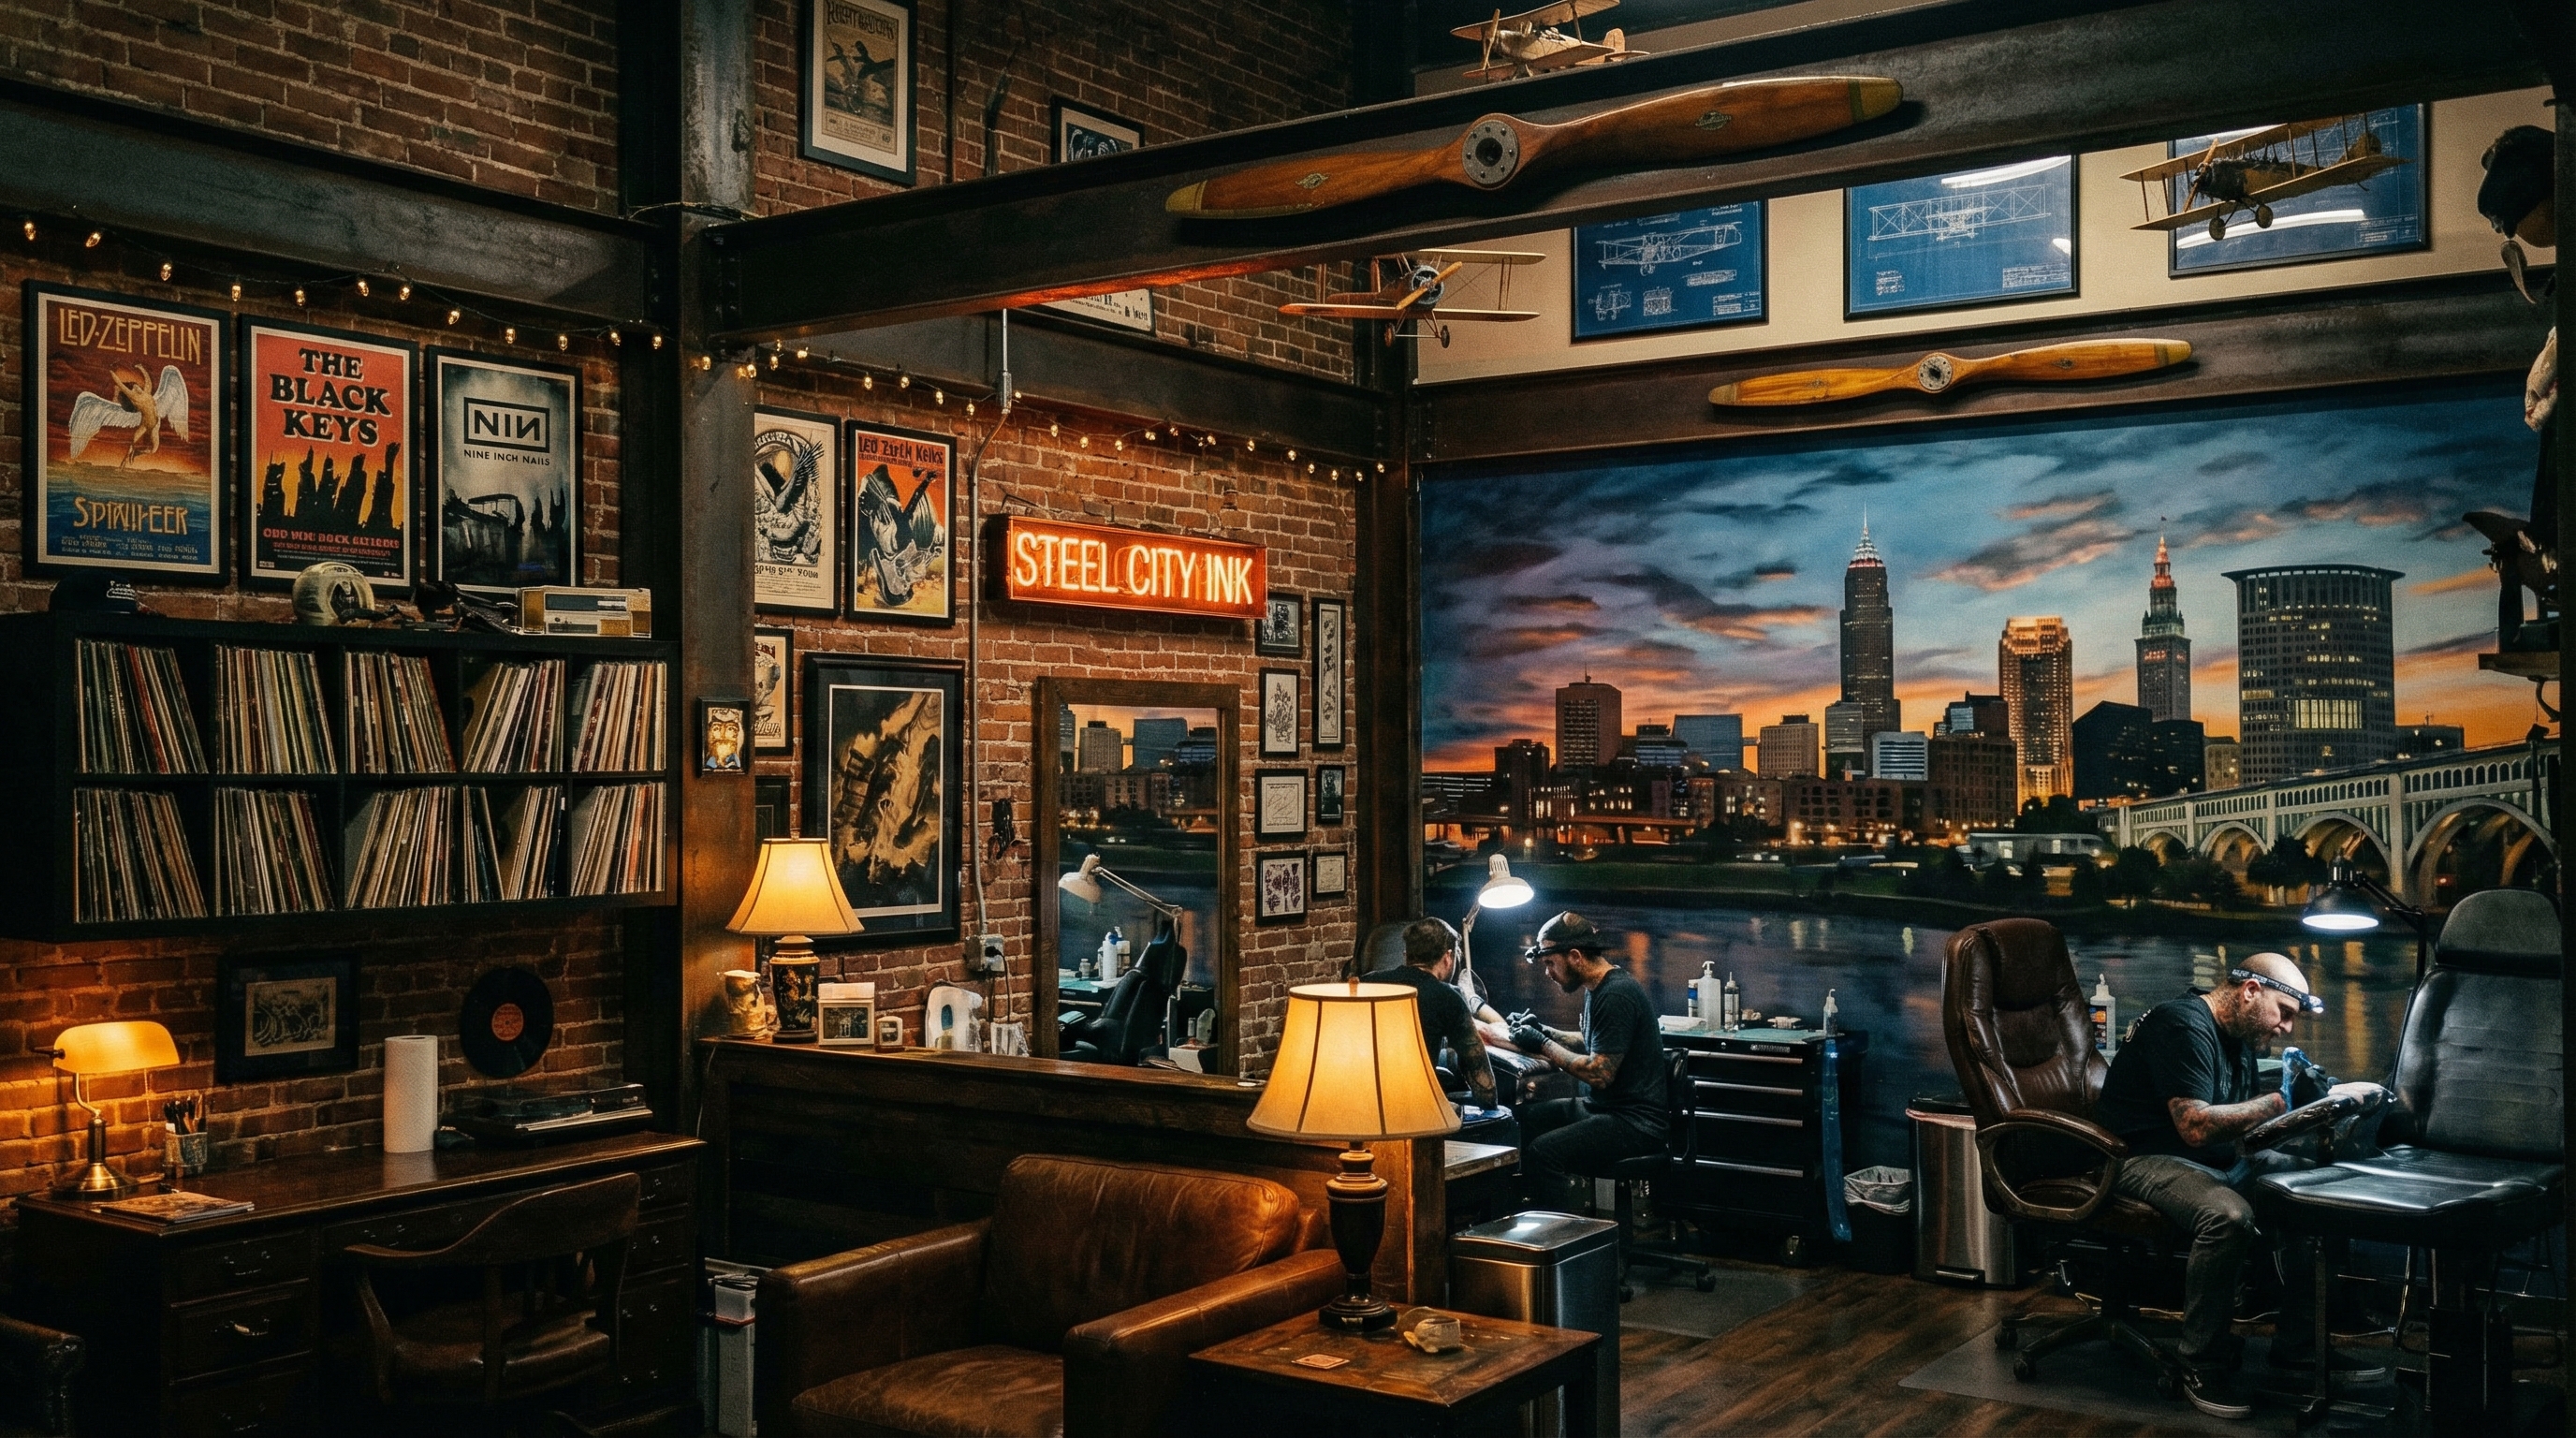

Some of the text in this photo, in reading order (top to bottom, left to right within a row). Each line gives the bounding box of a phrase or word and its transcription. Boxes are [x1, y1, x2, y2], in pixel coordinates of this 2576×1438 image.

[299, 347, 364, 382] THE
[270, 374, 393, 418] BLACK
[283, 408, 379, 448] KEYS
[463, 448, 550, 466] NINE INCH NAILS
[1016, 531, 1253, 606] STEEL CITY INK
